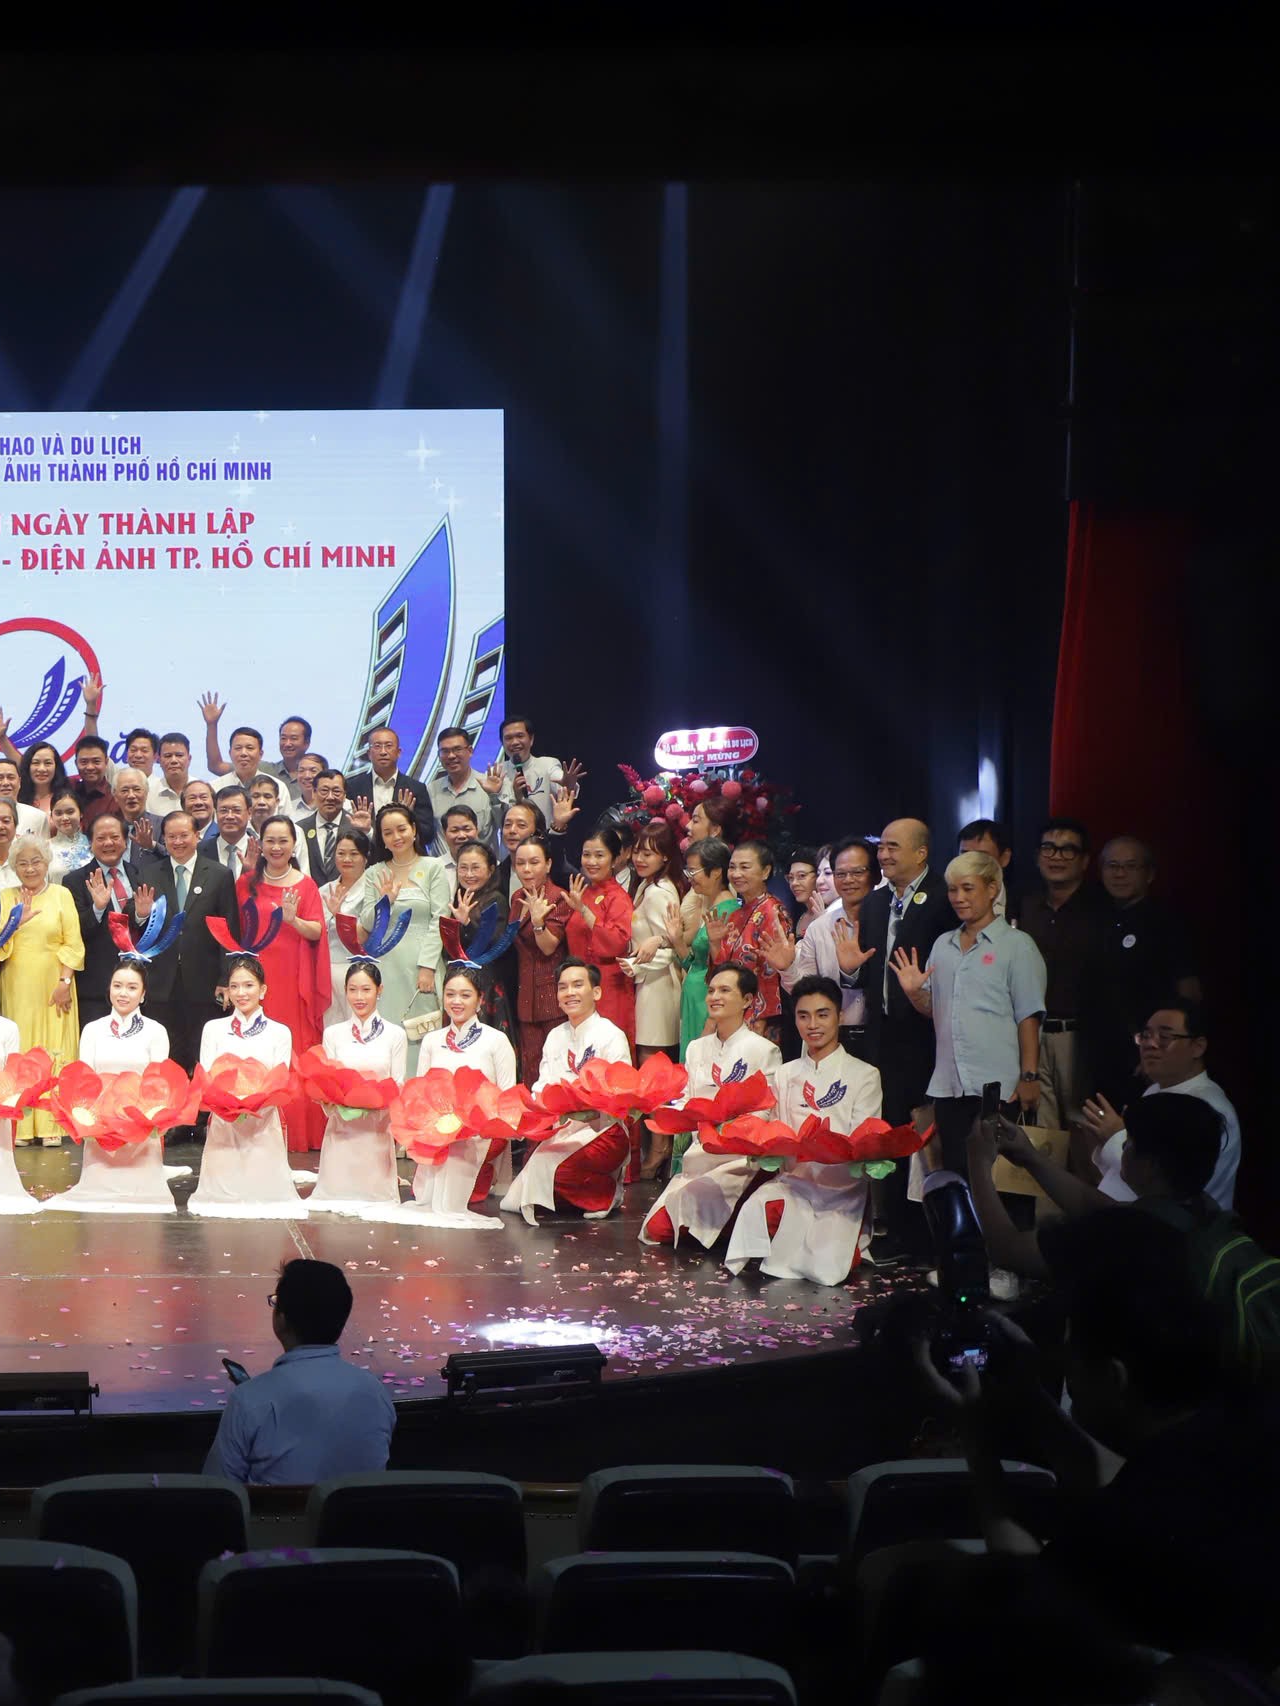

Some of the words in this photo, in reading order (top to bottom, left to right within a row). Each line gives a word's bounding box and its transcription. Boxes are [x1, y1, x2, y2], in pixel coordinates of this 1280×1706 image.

[42, 432, 64, 456] VÀ
[71, 436, 95, 456] DU
[101, 436, 142, 460] LỊCH
[4, 457, 41, 483] ẢNH
[48, 459, 107, 482] THÀNH
[113, 457, 150, 482] PHỐ
[156, 457, 180, 481] HỒ
[187, 459, 217, 481] CHÍ
[223, 461, 272, 481] MINH
[12, 508, 88, 536] NGÀY
[99, 508, 196, 535] THÀNH
[207, 506, 255, 540] LẬP
[21, 543, 85, 575] ĐIỆN
[96, 540, 156, 570] ẢNH
[167, 546, 201, 569] TP.
[212, 539, 254, 569] HỒ
[264, 540, 311, 568] CHÍ
[322, 544, 396, 568] MINH
